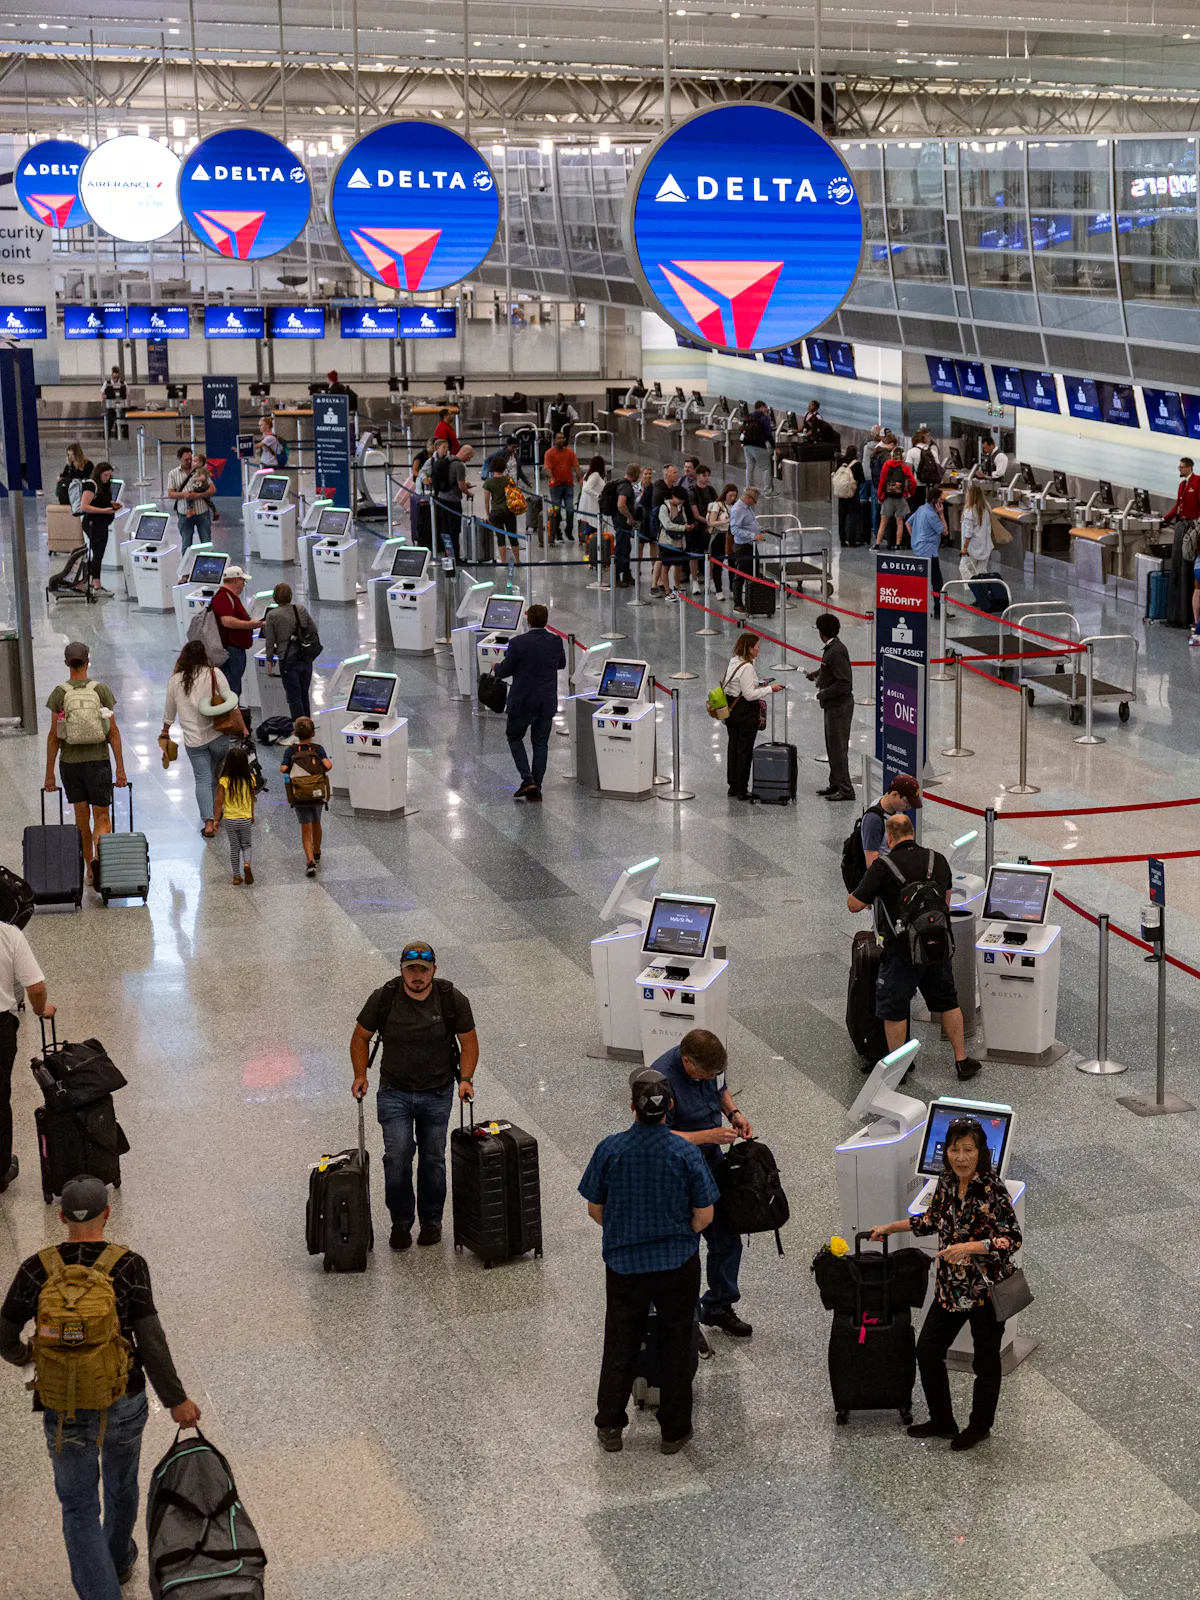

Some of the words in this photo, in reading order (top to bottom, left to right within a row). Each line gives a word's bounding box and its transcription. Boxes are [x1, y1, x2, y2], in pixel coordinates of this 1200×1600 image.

[39, 164, 79, 175] DELT
[214, 166, 284, 182] DELTA
[378, 170, 466, 190] DELTA
[697, 176, 817, 203] DELTA
[889, 562, 916, 571] DELTA
[879, 587, 898, 596] SKY
[879, 595, 922, 607] PRIORITY
[879, 646, 902, 655] AGENT
[902, 649, 925, 658] ASSIST
[891, 690, 905, 700] DELTA
[894, 702, 915, 724] ONE
[998, 991, 1022, 999] DELTA
